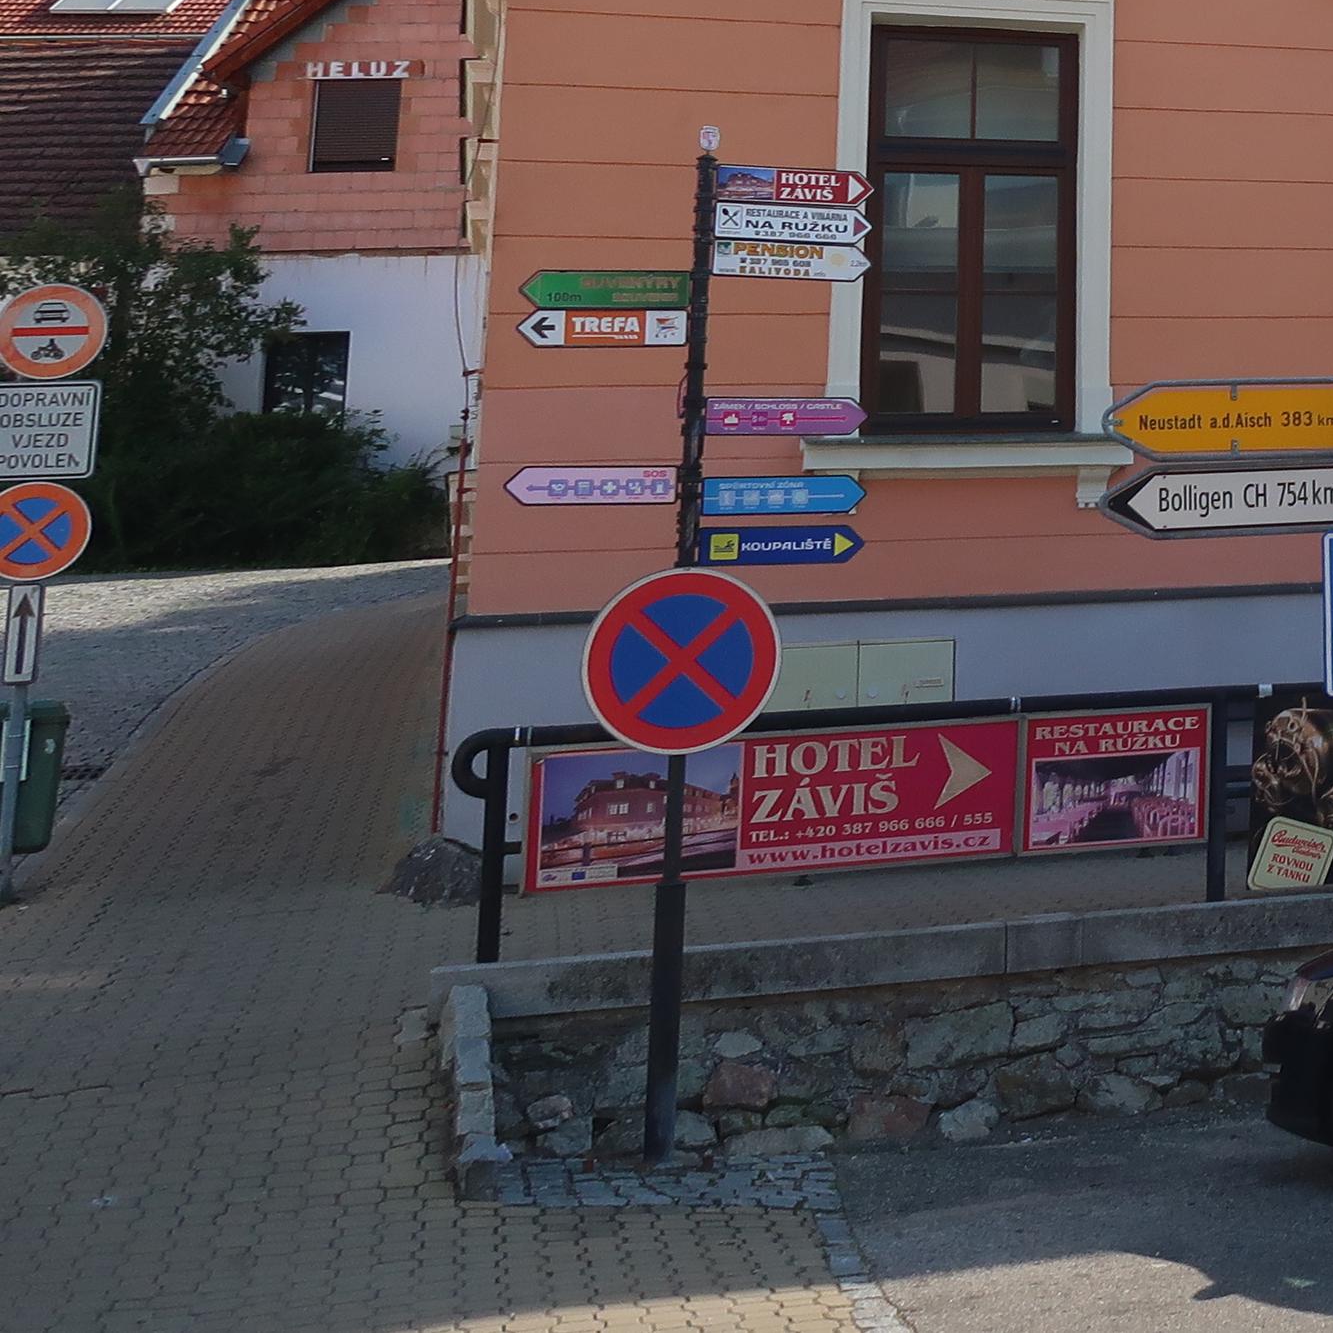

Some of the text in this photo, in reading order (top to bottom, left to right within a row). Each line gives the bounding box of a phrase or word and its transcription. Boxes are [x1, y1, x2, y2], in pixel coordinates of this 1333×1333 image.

[306, 60, 410, 77] HELUZ
[781, 172, 840, 186] HOTEL
[780, 184, 833, 200] ZÁVIŠ
[745, 208, 800, 220] RESTAURACE
[802, 211, 808, 220] A
[745, 220, 774, 230] NA
[733, 242, 824, 259] PENSION
[739, 266, 811, 277] KALIVODA
[547, 293, 582, 302] 100m
[572, 317, 640, 332] TREFA
[0, 388, 93, 407] DOPRAVNÍ
[0, 412, 84, 428] OBSLUZE
[1138, 414, 1202, 430] Neustadt
[1280, 411, 1313, 427] 383
[12, 433, 69, 448] VJEZD
[642, 470, 667, 478] SOS
[1158, 487, 1233, 518] Bolligen
[1243, 483, 1268, 508] CH
[741, 537, 832, 551] KOUPALIŠTĚ
[1034, 716, 1200, 740] RESTAURACE
[1054, 741, 1089, 756] NA
[752, 735, 921, 779] HOTEL
[750, 773, 899, 824] ZÁVIŠ
[750, 812, 993, 843] TEL.: +420 387 966 666 / 555
[747, 834, 990, 865] www.hotelzavis.cz
[1271, 853, 1314, 872] ROVNOU
[1266, 863, 1311, 884] Z TANKU
